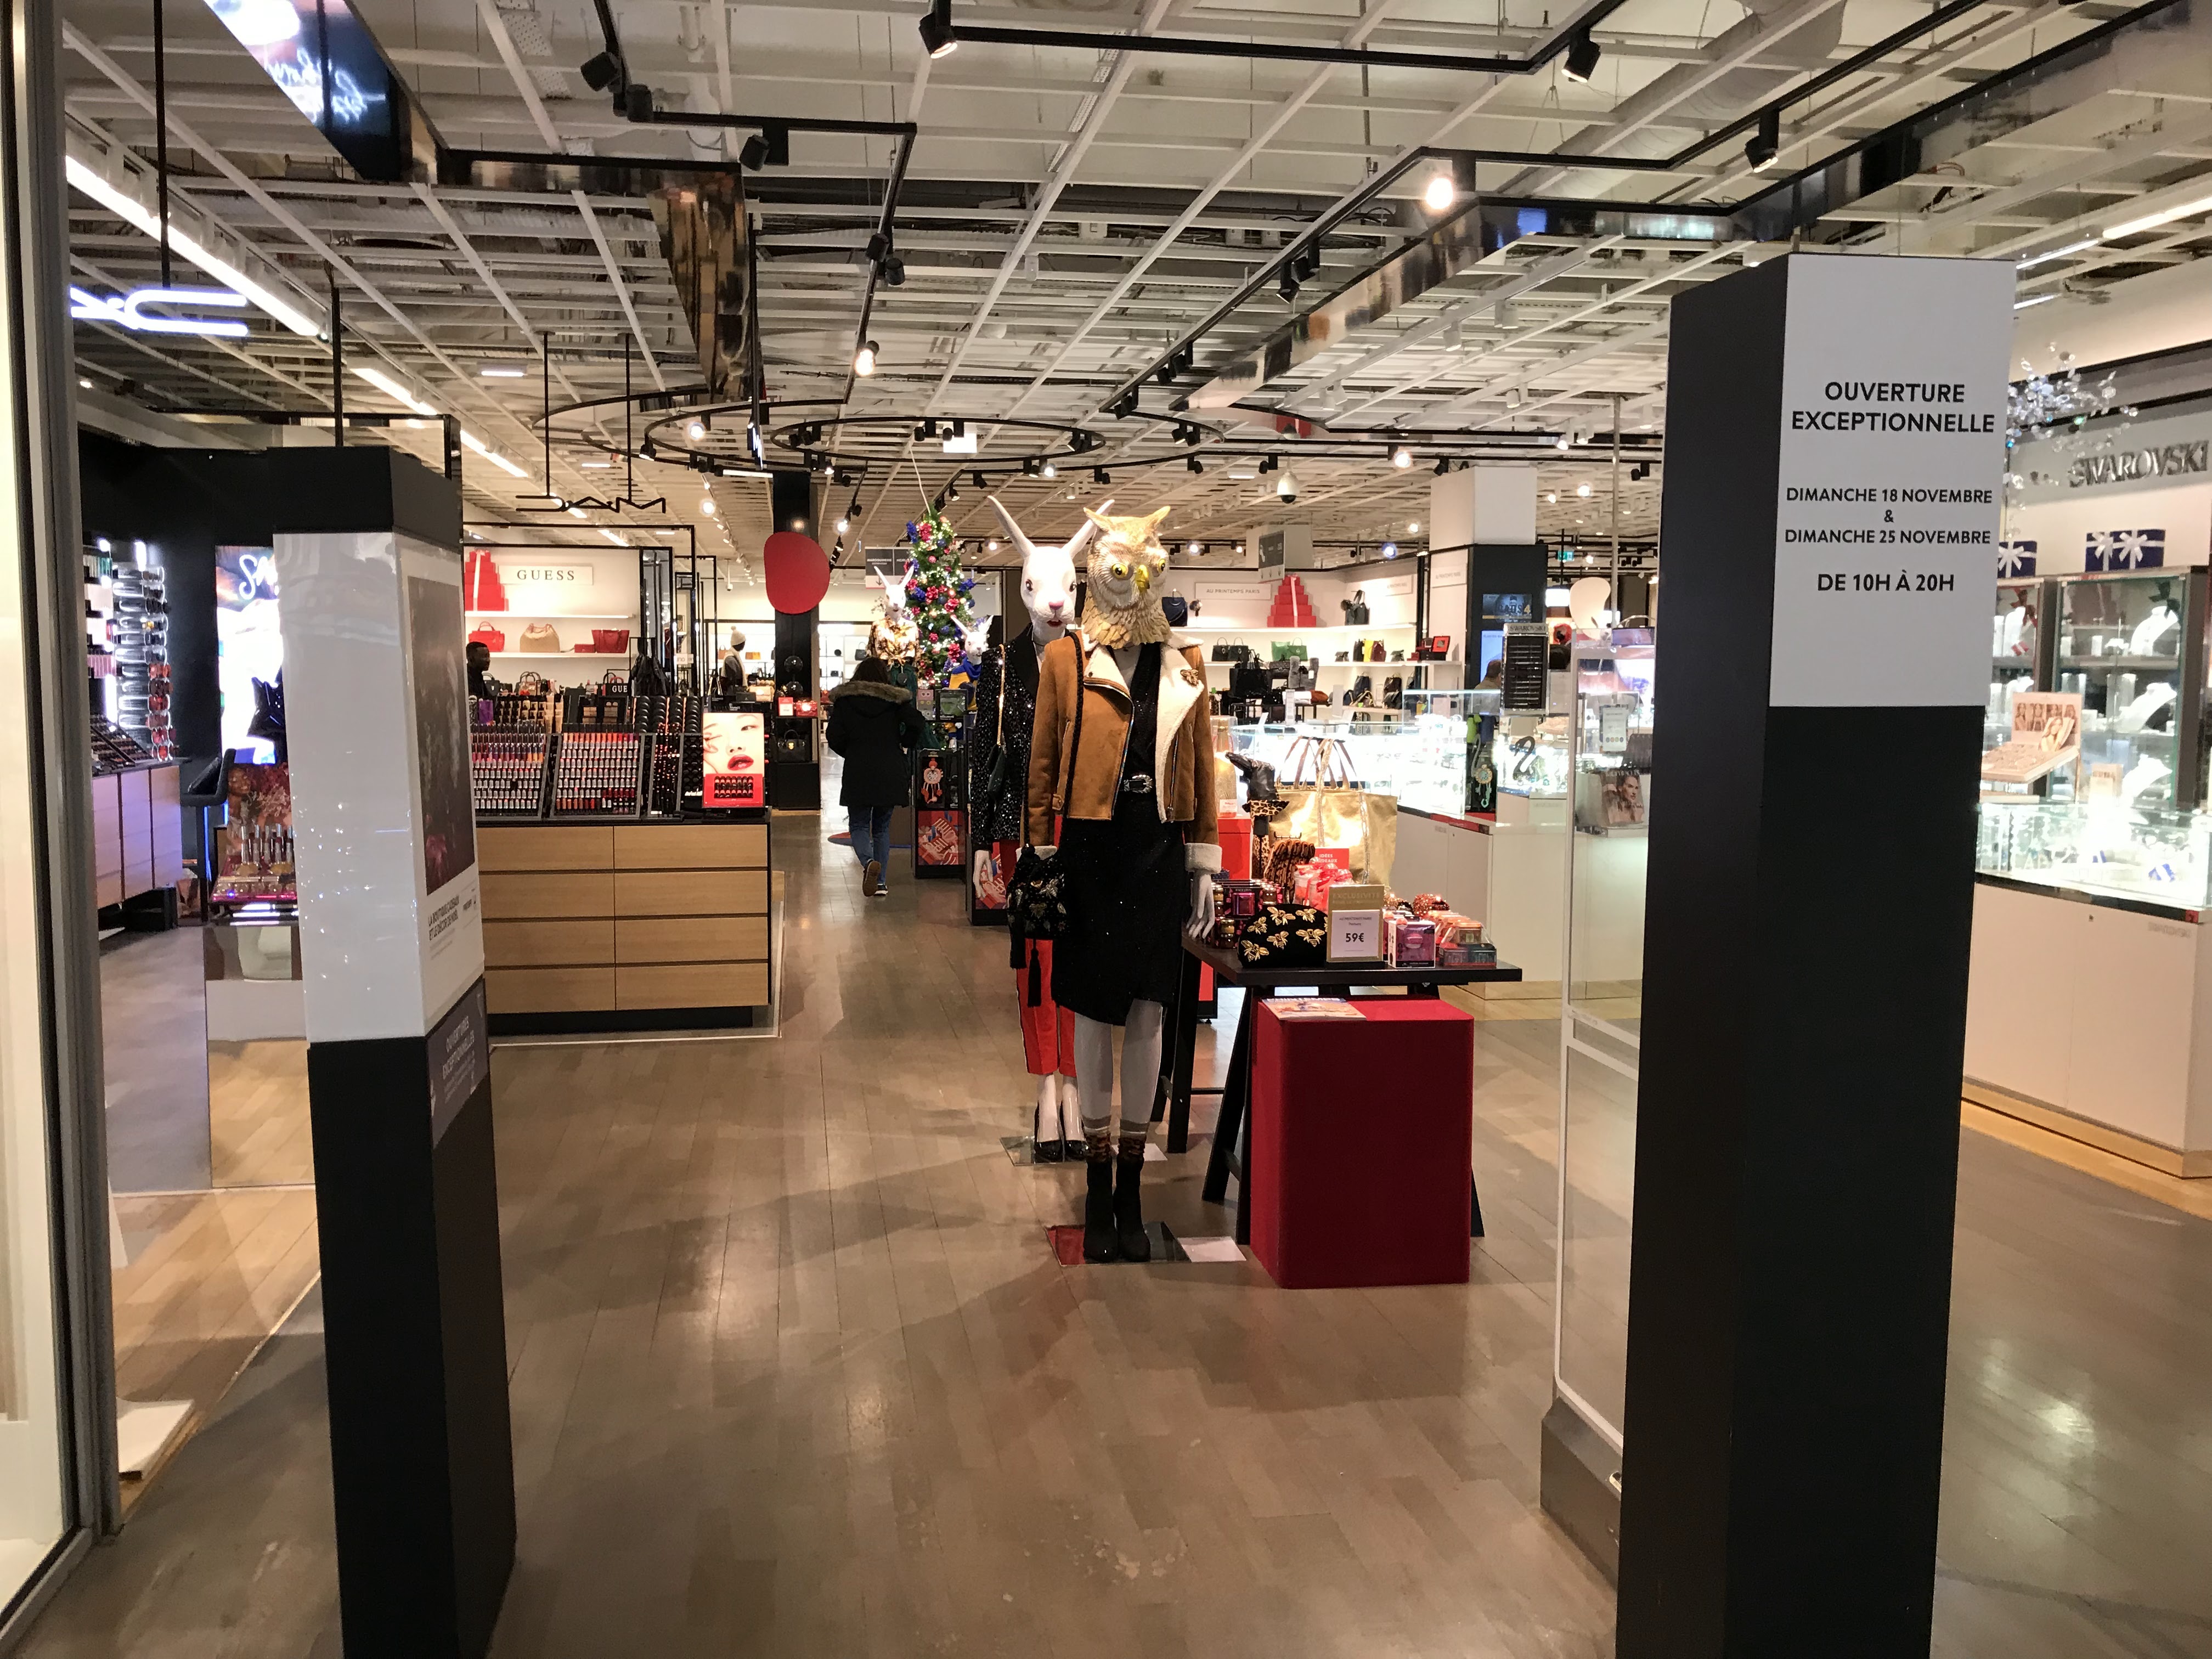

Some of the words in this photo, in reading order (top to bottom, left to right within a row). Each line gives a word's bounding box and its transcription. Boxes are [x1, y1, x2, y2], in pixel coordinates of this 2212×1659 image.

[1825, 382, 1965, 403] OUVERTURE
[1792, 411, 1995, 432] EXCEPTIONNELLE
[2068, 441, 2209, 487] SWAROVSKI
[1786, 488, 1877, 502] DIMANCHE
[1882, 489, 1898, 502] 18
[1902, 489, 1993, 504] NOVEMBRE
[1884, 509, 1894, 523] &
[1785, 529, 1875, 544] DIMANCHE
[1880, 530, 1895, 544] 25
[1900, 531, 1991, 544] NOVEMBRE
[517, 569, 574, 581] GUESS
[1818, 573, 1846, 591] DE
[1853, 574, 1891, 591] 10H
[1895, 569, 1911, 591] À
[1916, 574, 1954, 592] 20H
[1345, 932, 1364, 943] 59€
